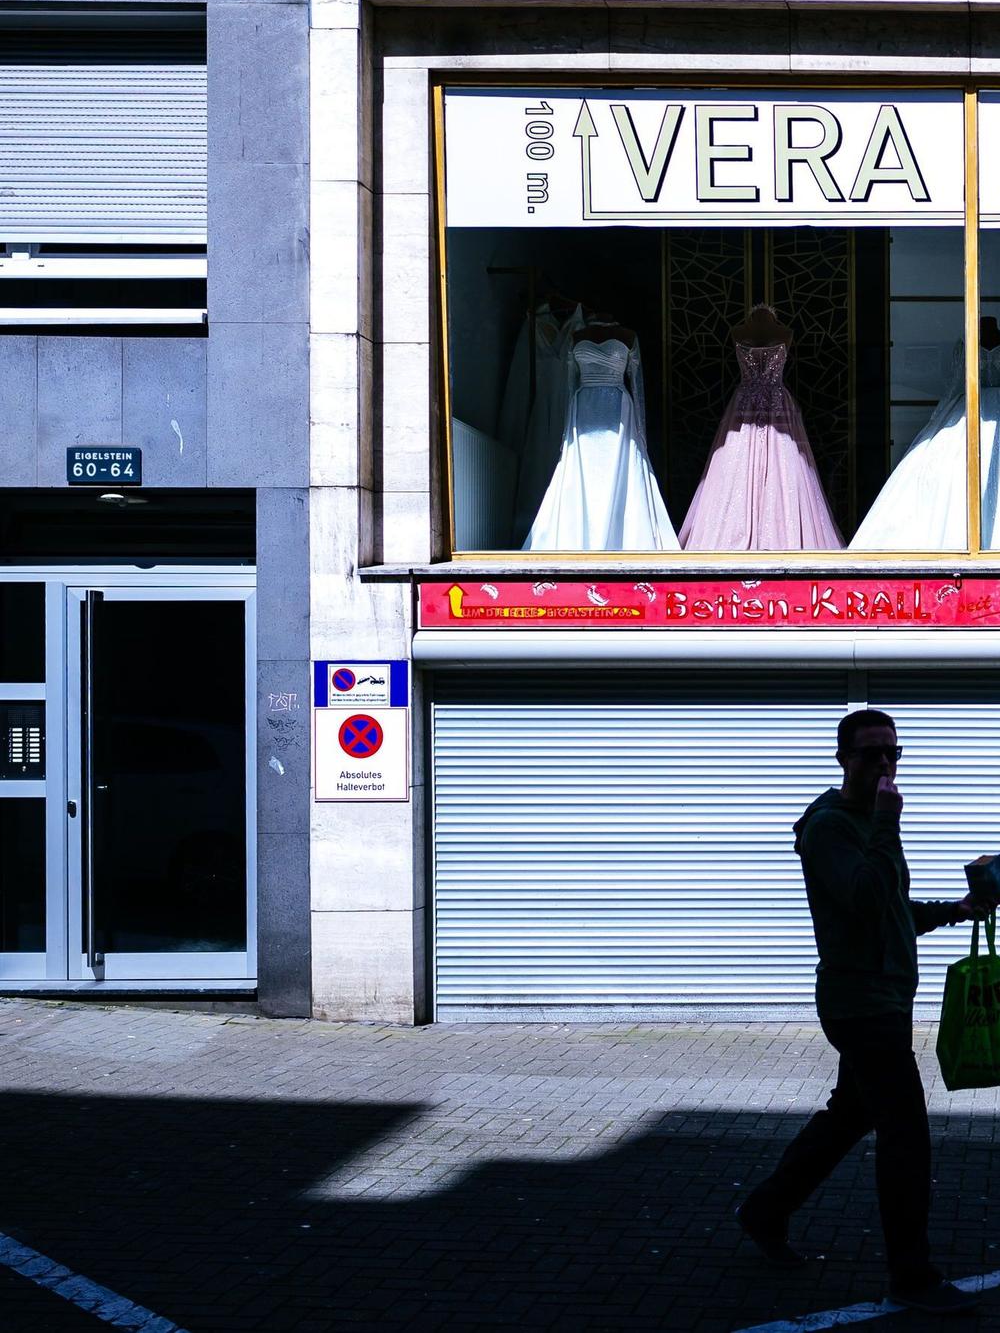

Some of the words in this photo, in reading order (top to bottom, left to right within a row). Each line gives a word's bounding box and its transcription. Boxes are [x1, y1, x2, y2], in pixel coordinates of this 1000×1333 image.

[525, 101, 554, 161] 100
[609, 104, 931, 202] VERA
[526, 172, 548, 214] m.
[74, 452, 132, 460] EIGELSTEIN
[73, 462, 134, 477] 60-64
[546, 607, 614, 618] EIGELSTEIN
[339, 771, 382, 779] Absolutes
[336, 783, 385, 791] Halteverbot
